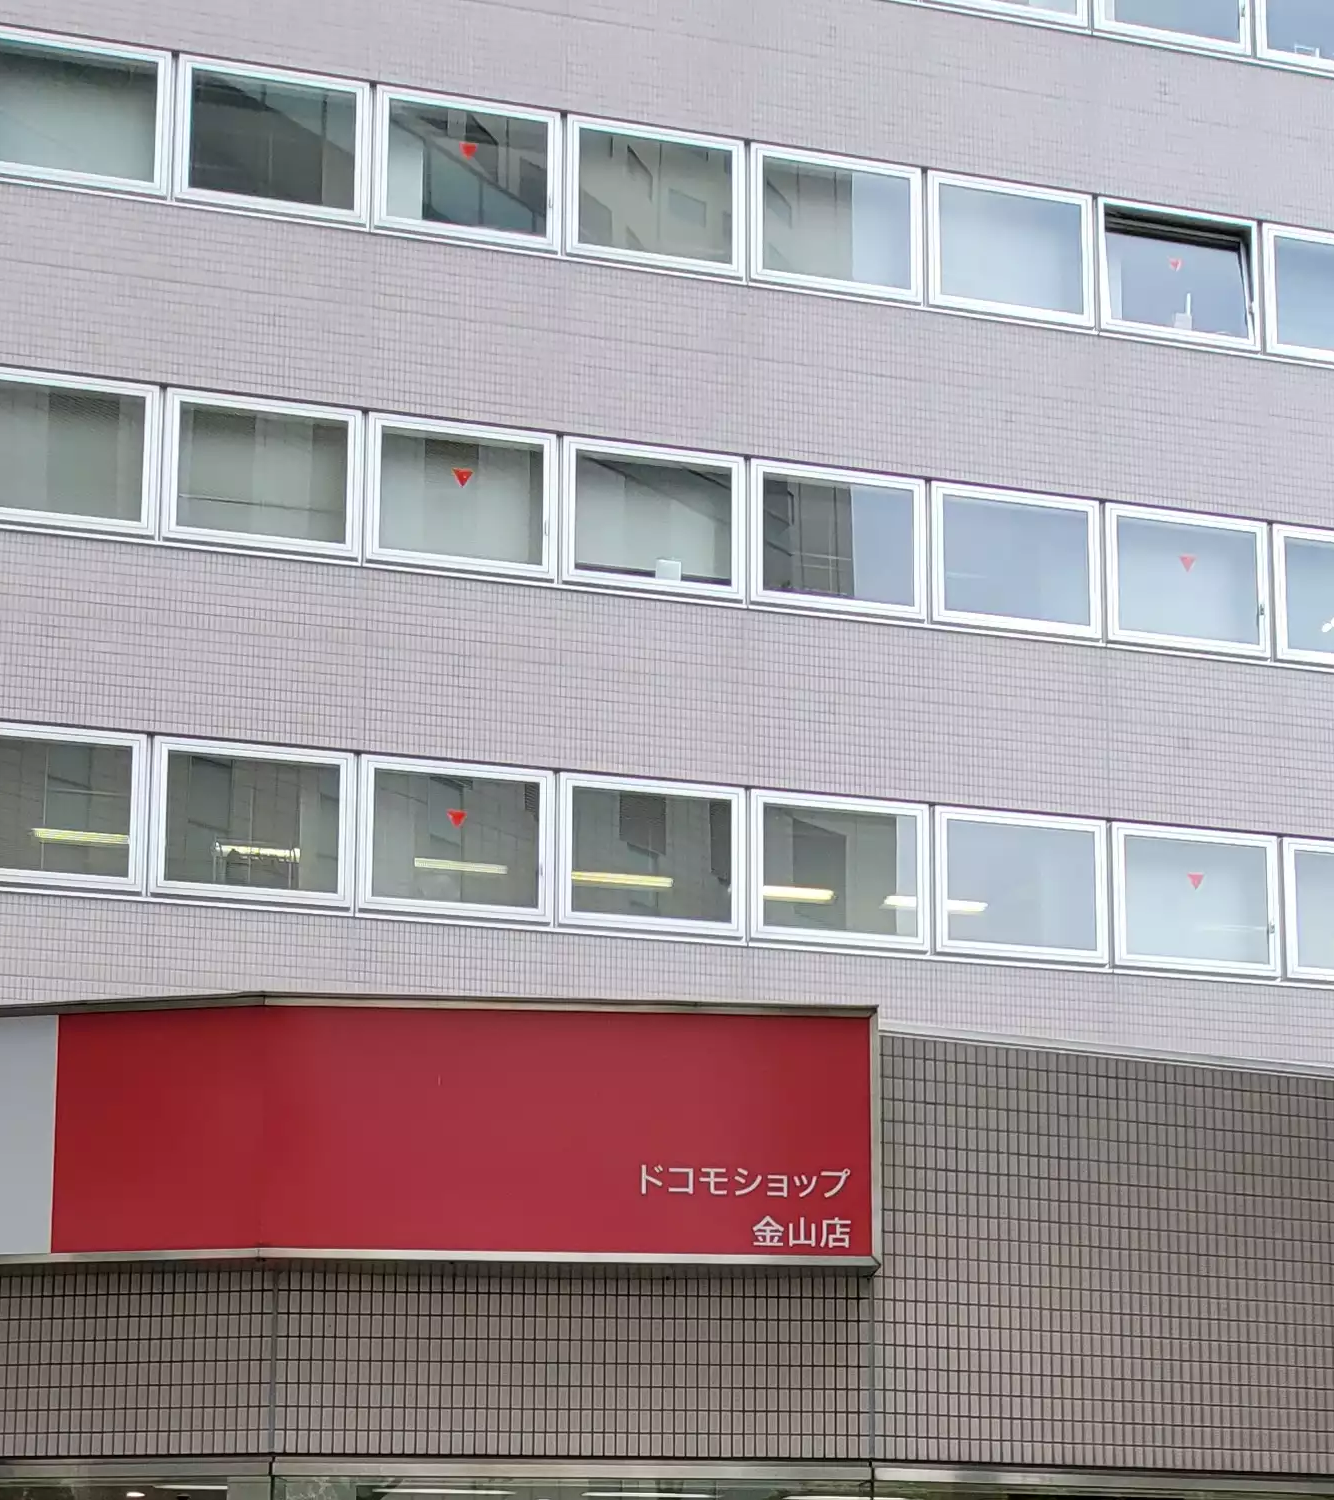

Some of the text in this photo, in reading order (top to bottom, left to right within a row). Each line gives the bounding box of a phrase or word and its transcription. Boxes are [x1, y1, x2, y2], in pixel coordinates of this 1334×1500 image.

[640, 1164, 851, 1198] ドコモショップ
[752, 1215, 852, 1248] 金山店
